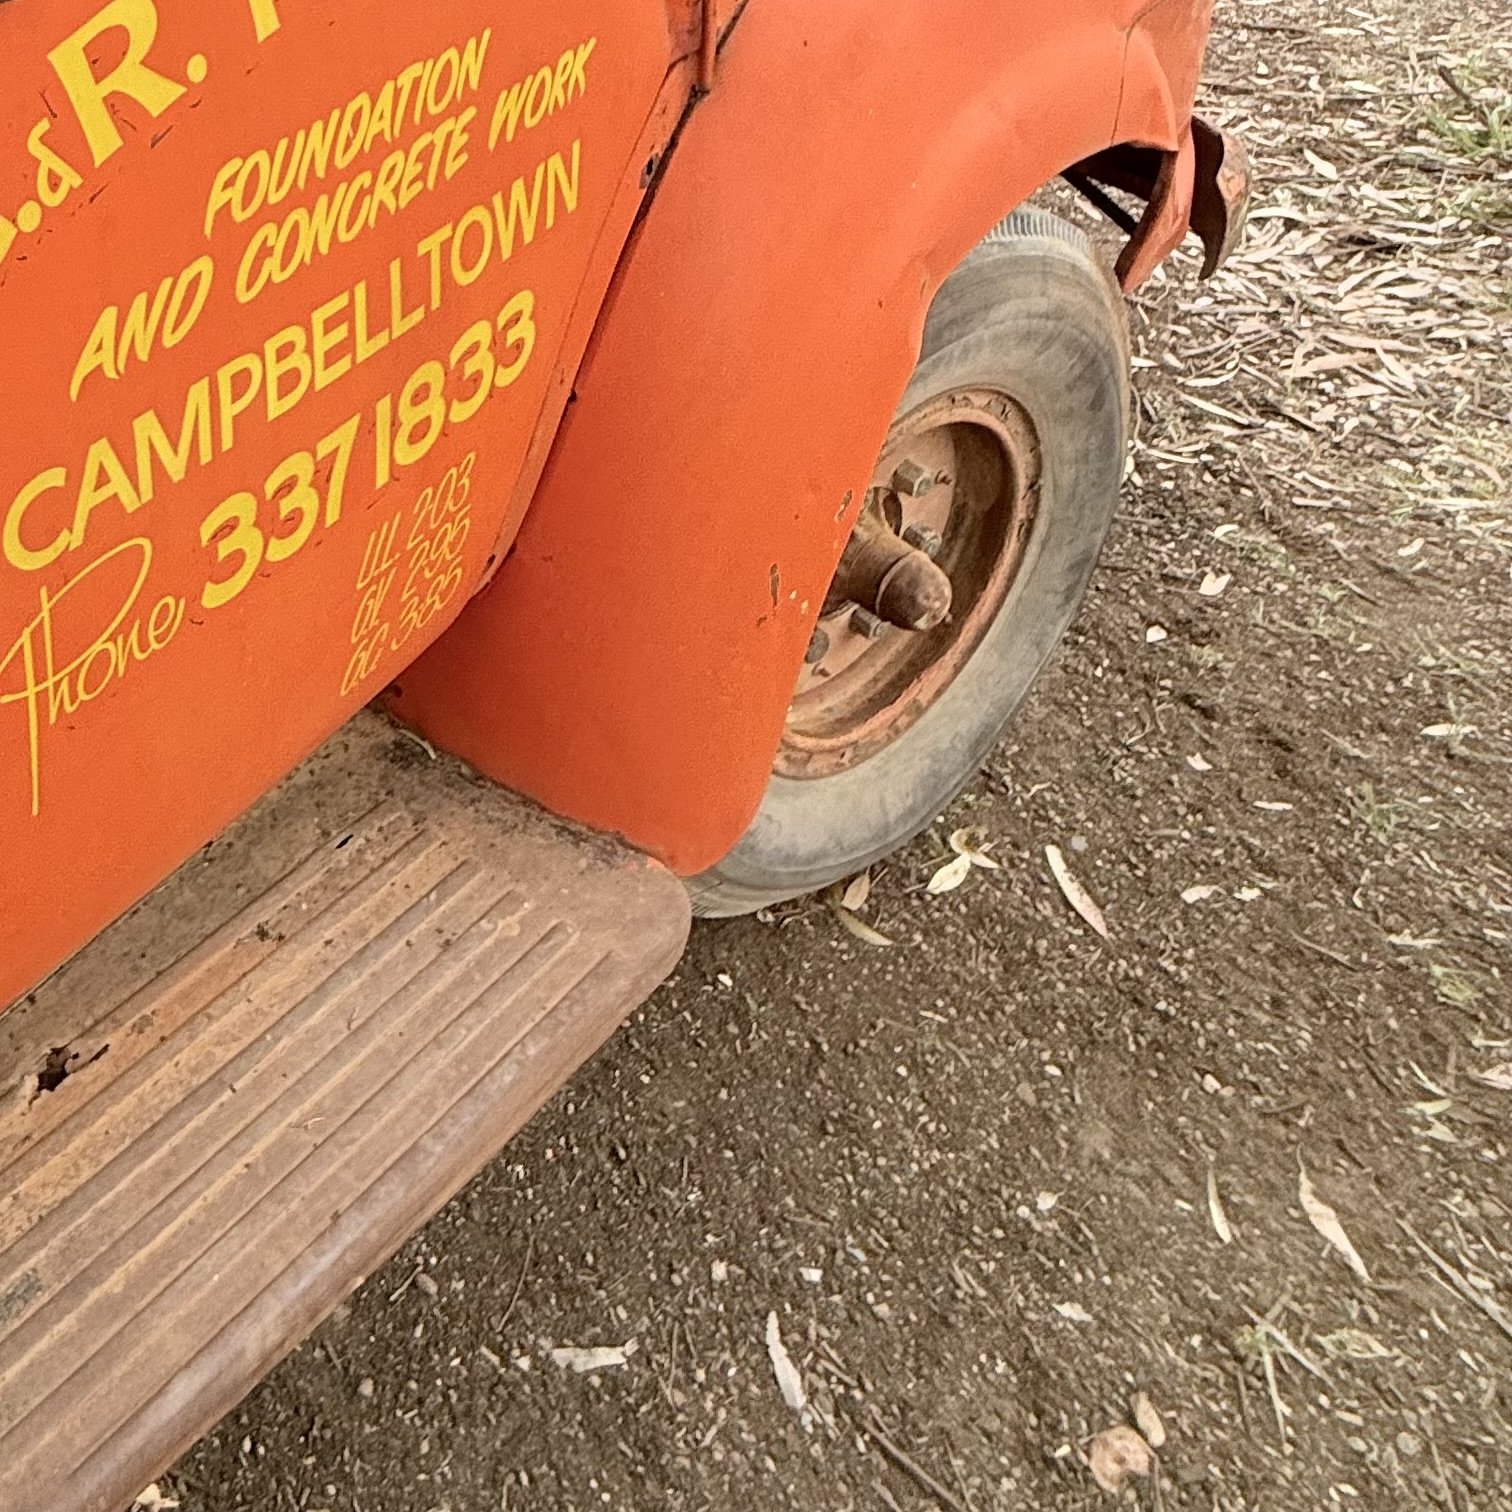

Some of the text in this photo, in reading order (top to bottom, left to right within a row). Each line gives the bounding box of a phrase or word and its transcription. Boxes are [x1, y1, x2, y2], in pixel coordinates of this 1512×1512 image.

[70, 37, 597, 403] AND CONCRETE WORK
[203, 28, 491, 240] FOUNDATION
[3, 139, 580, 571] CAMPBELLTOWN
